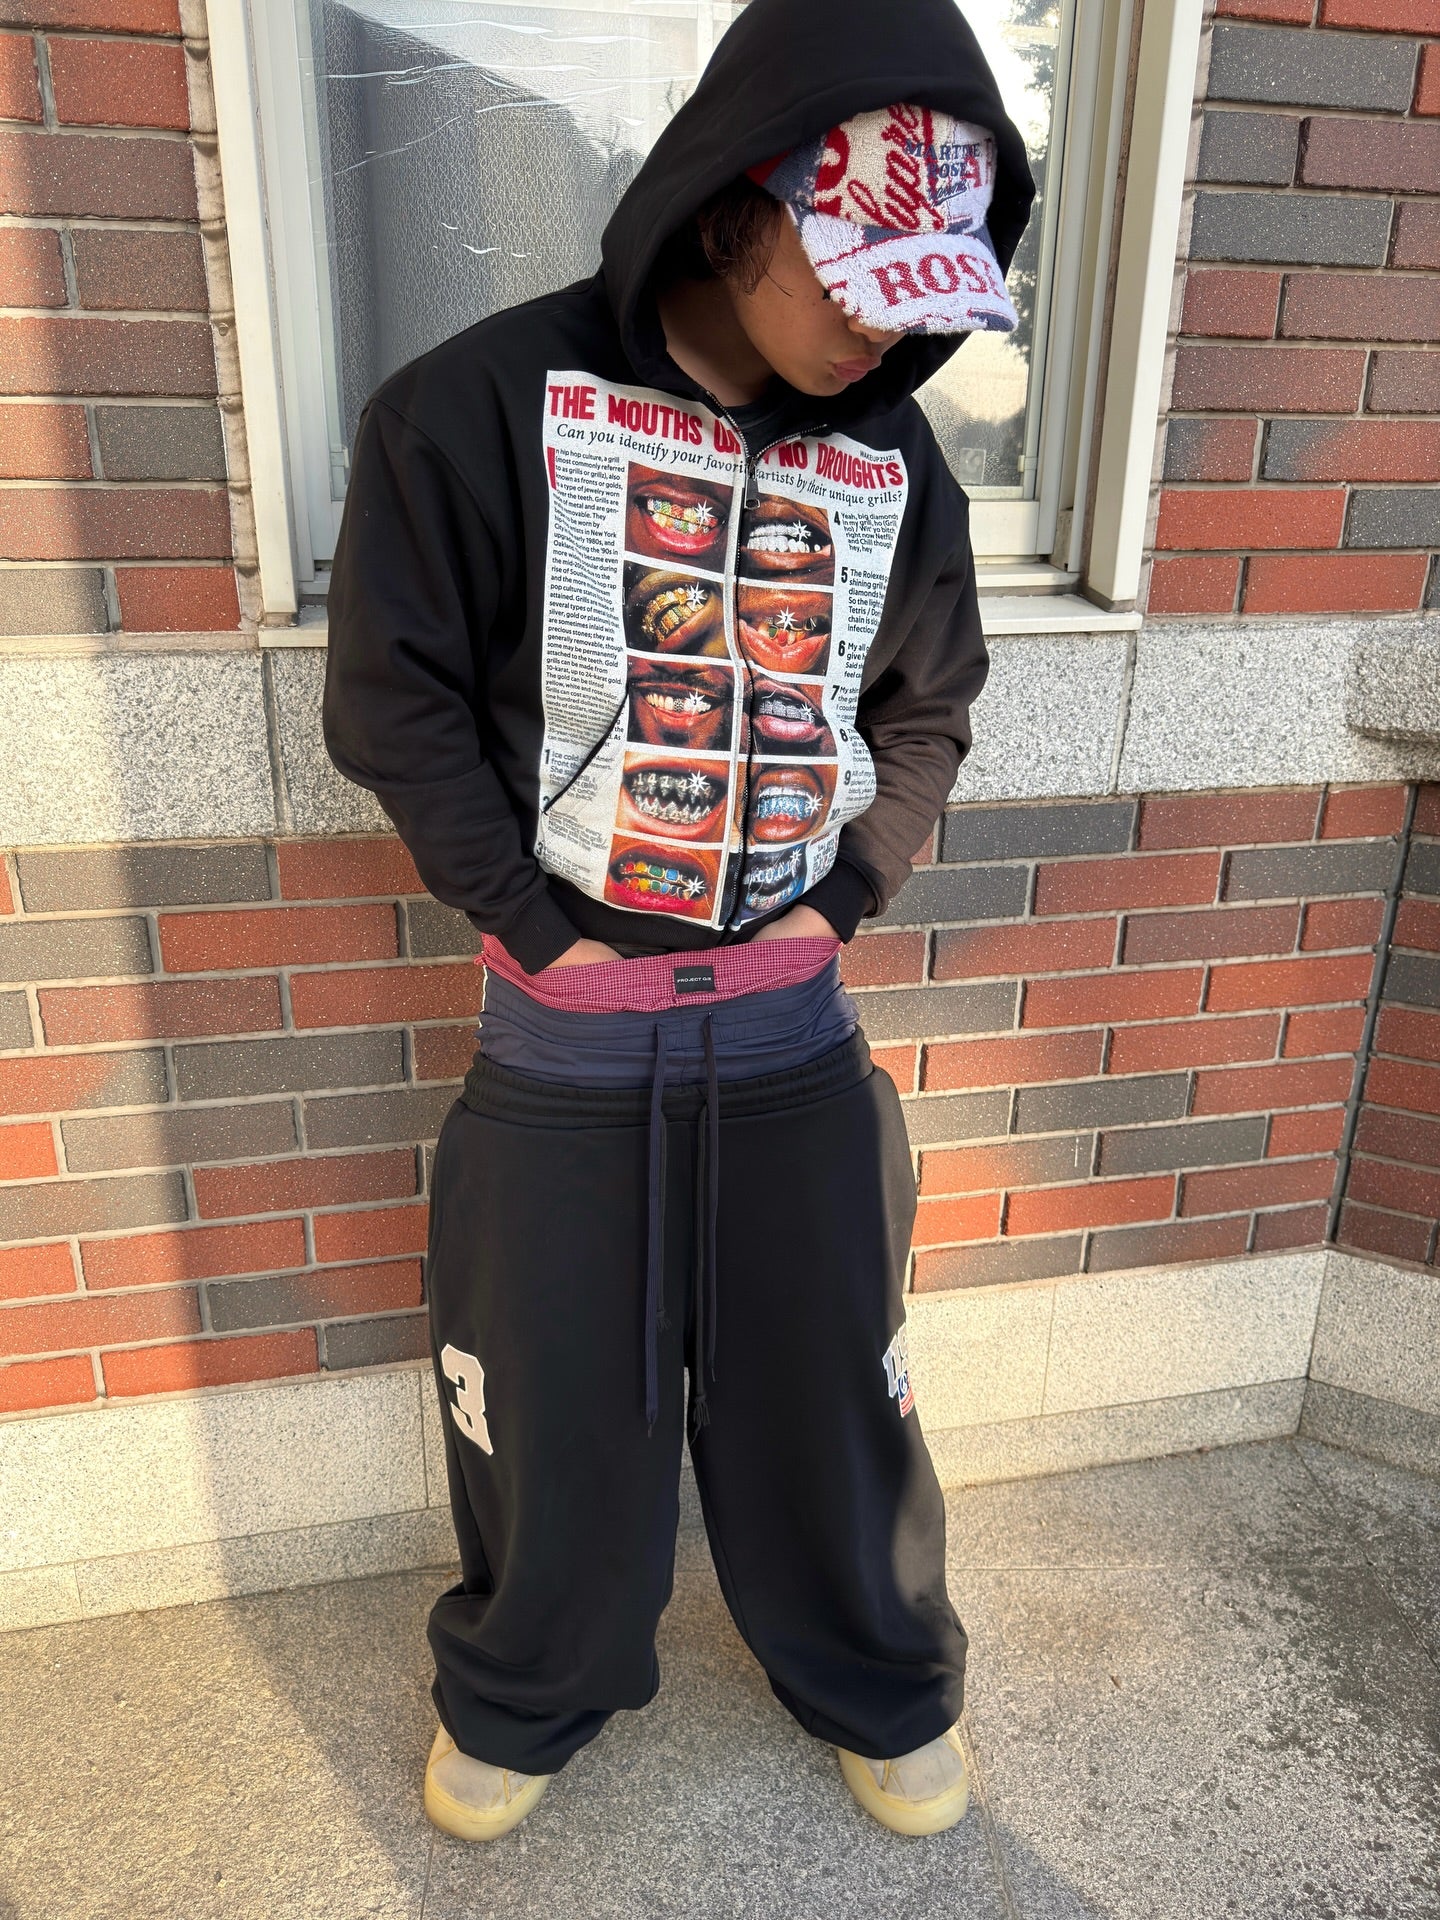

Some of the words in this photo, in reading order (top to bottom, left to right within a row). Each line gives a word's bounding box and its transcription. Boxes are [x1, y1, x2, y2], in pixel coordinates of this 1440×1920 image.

[927, 161, 967, 179] ROSE
[548, 385, 597, 420] THE
[608, 393, 702, 445] MOUTHS
[583, 454, 603, 462] culture,
[557, 423, 585, 440] Can
[588, 430, 615, 446] you
[619, 433, 668, 461] identify
[670, 449, 704, 464] your
[758, 468, 795, 485] artists
[797, 473, 807, 493] by
[807, 479, 827, 497] their
[829, 489, 864, 507] unique
[868, 490, 903, 508] grills?
[572, 460, 600, 470] commonly
[601, 464, 624, 472] referred
[778, 440, 808, 469] NO
[815, 442, 903, 489] DROUGHTS
[556, 472, 573, 481] known
[581, 478, 597, 486] fronts
[606, 482, 623, 490] golds,
[584, 487, 604, 495] jewelry
[834, 511, 840, 525] 4
[599, 565, 617, 573] during
[841, 567, 848, 583] 5
[850, 569, 862, 577] The
[863, 571, 884, 580] Rolexes
[563, 585, 582, 593] culture
[850, 579, 871, 589] shining
[550, 593, 574, 601] attained.
[849, 588, 878, 598] diamonds
[549, 609, 565, 617] silver,
[848, 606, 866, 614] Tetris
[848, 615, 864, 623] chain
[559, 620, 588, 628] sometimes
[589, 623, 603, 631] inlaid
[548, 626, 571, 634] precious
[593, 633, 605, 641] they
[548, 635, 573, 643] generally
[574, 638, 604, 649] removable,
[605, 644, 623, 652] though
[838, 640, 845, 656] 6
[848, 643, 857, 651] My
[547, 650, 571, 658] attached
[583, 649, 617, 660] permanently
[847, 652, 861, 660] give
[831, 685, 840, 700] 7
[557, 695, 579, 703] hundred
[583, 694, 606, 703] anywhere
[840, 728, 848, 742] 8
[545, 749, 550, 764] 1
[844, 770, 851, 785] 9
[441, 1343, 493, 1455] 3
